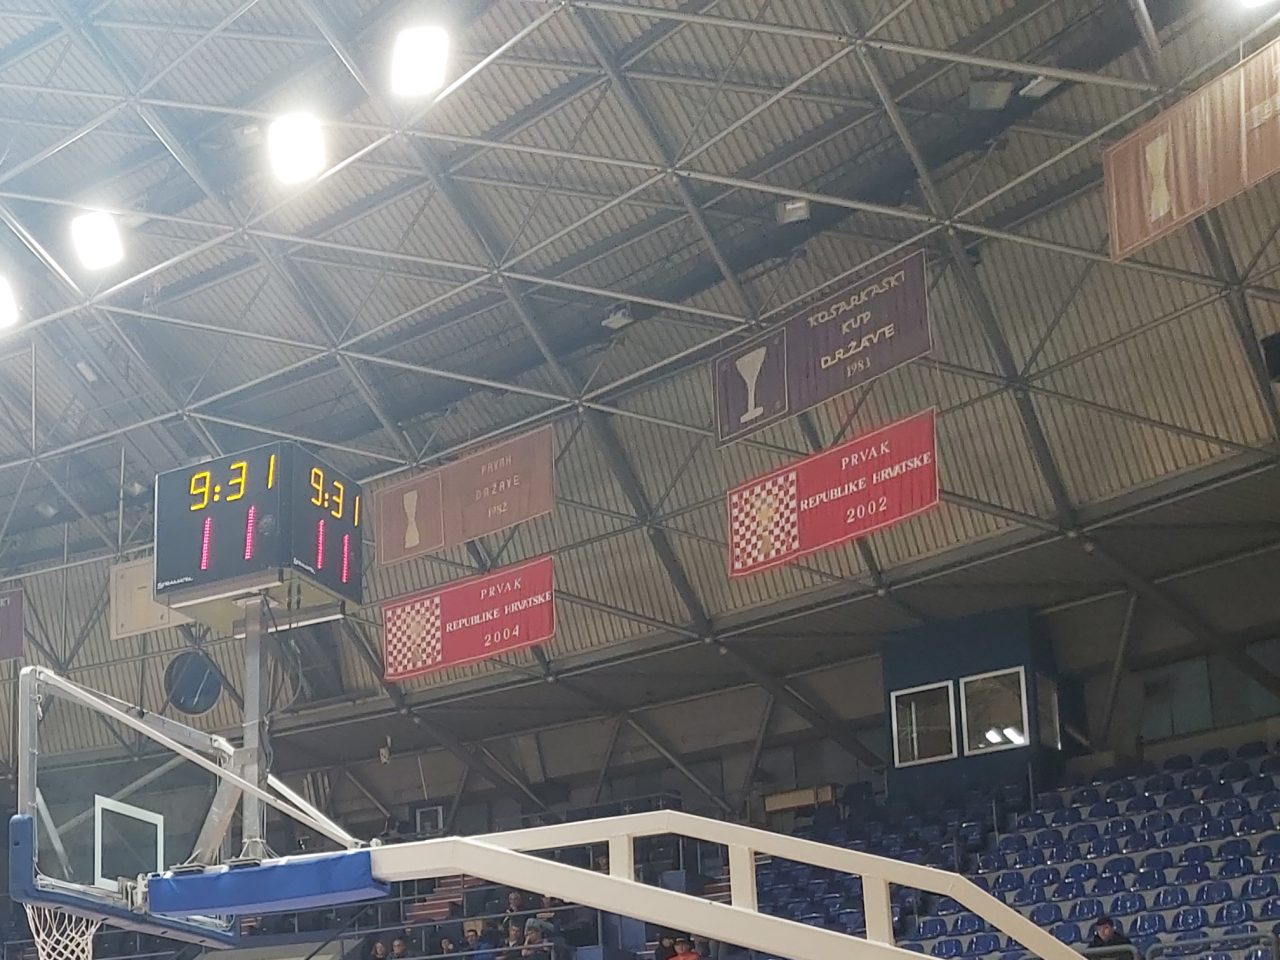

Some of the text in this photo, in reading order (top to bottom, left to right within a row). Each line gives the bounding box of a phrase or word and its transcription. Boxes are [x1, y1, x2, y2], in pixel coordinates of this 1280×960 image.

[842, 311, 871, 334] KUP
[841, 440, 891, 470] PRVAK
[190, 454, 275, 511] 9:31
[311, 467, 360, 527] 9:31
[800, 452, 932, 512] REPUBLIKE HRVATSKE
[846, 497, 888, 523] 2002
[480, 577, 523, 601] PRVAK
[446, 590, 552, 632] REPUBLIKE HRVATSKE
[484, 624, 520, 647] 2004
